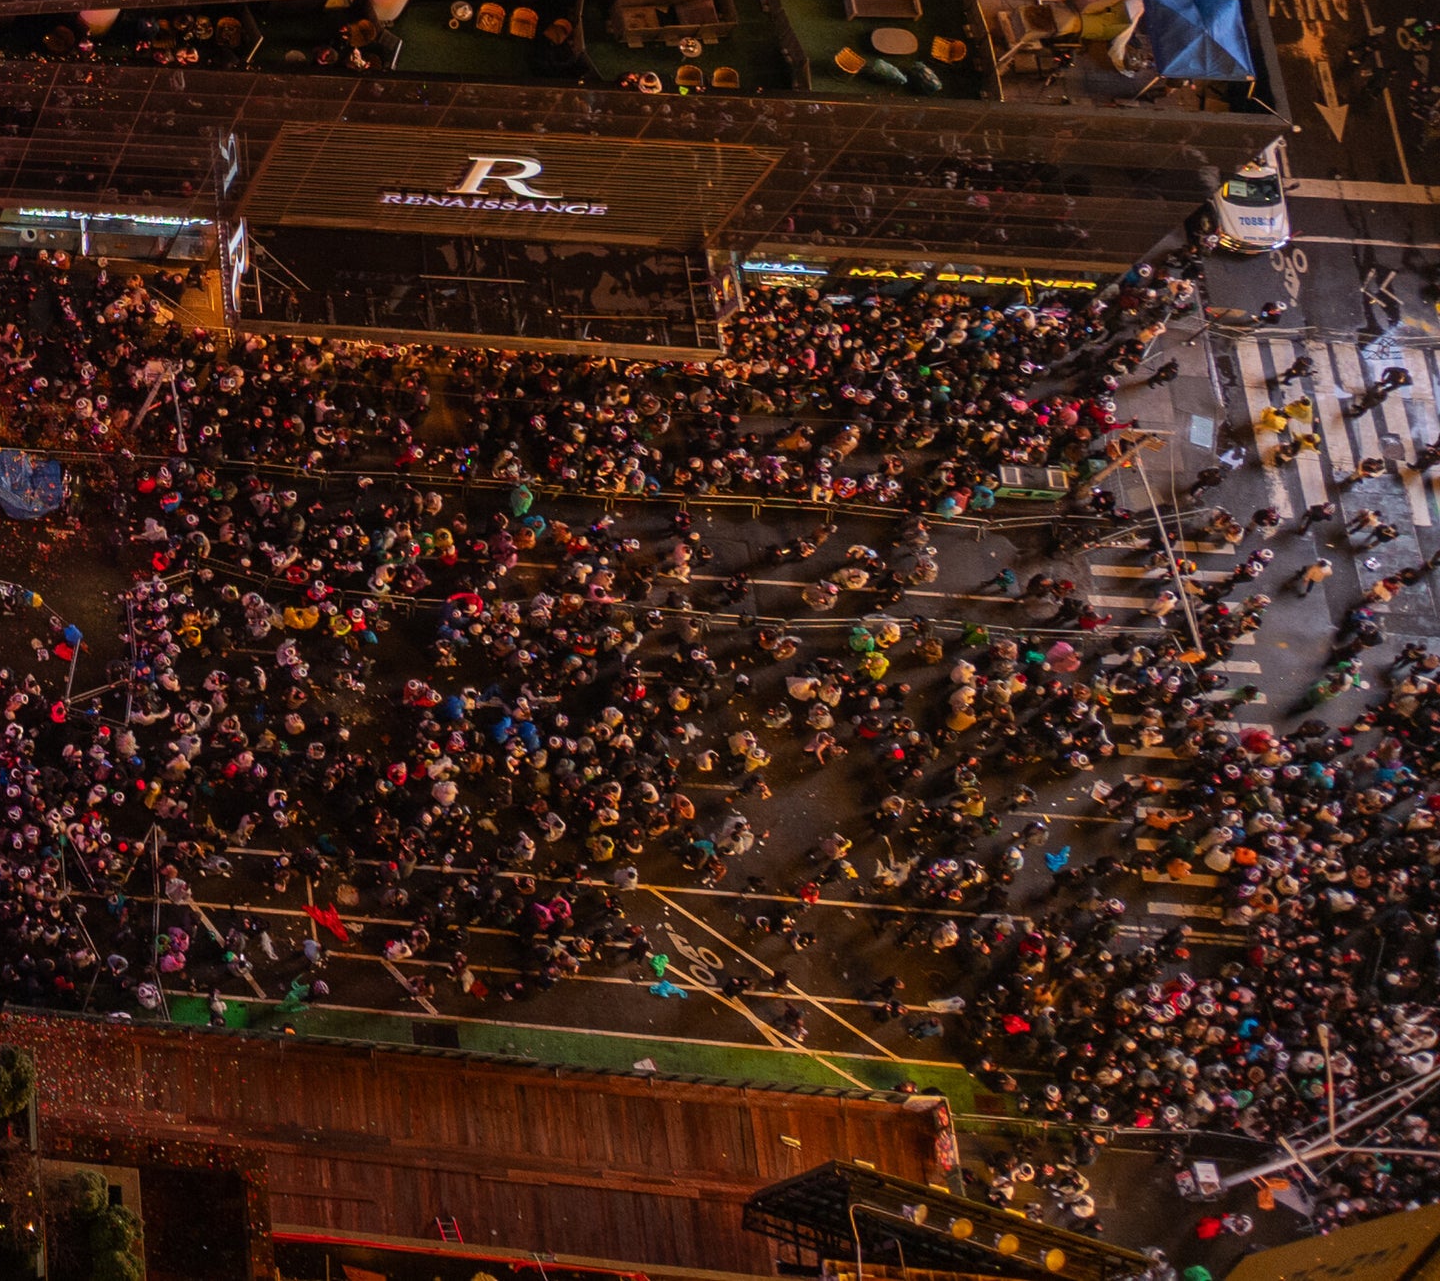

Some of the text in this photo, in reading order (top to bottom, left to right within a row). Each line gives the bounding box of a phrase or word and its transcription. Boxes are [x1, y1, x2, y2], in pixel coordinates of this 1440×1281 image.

[450, 154, 563, 201] R
[380, 190, 608, 217] RENAISSANCE
[848, 266, 924, 282] MAX
[936, 272, 1097, 291] BRENNER
